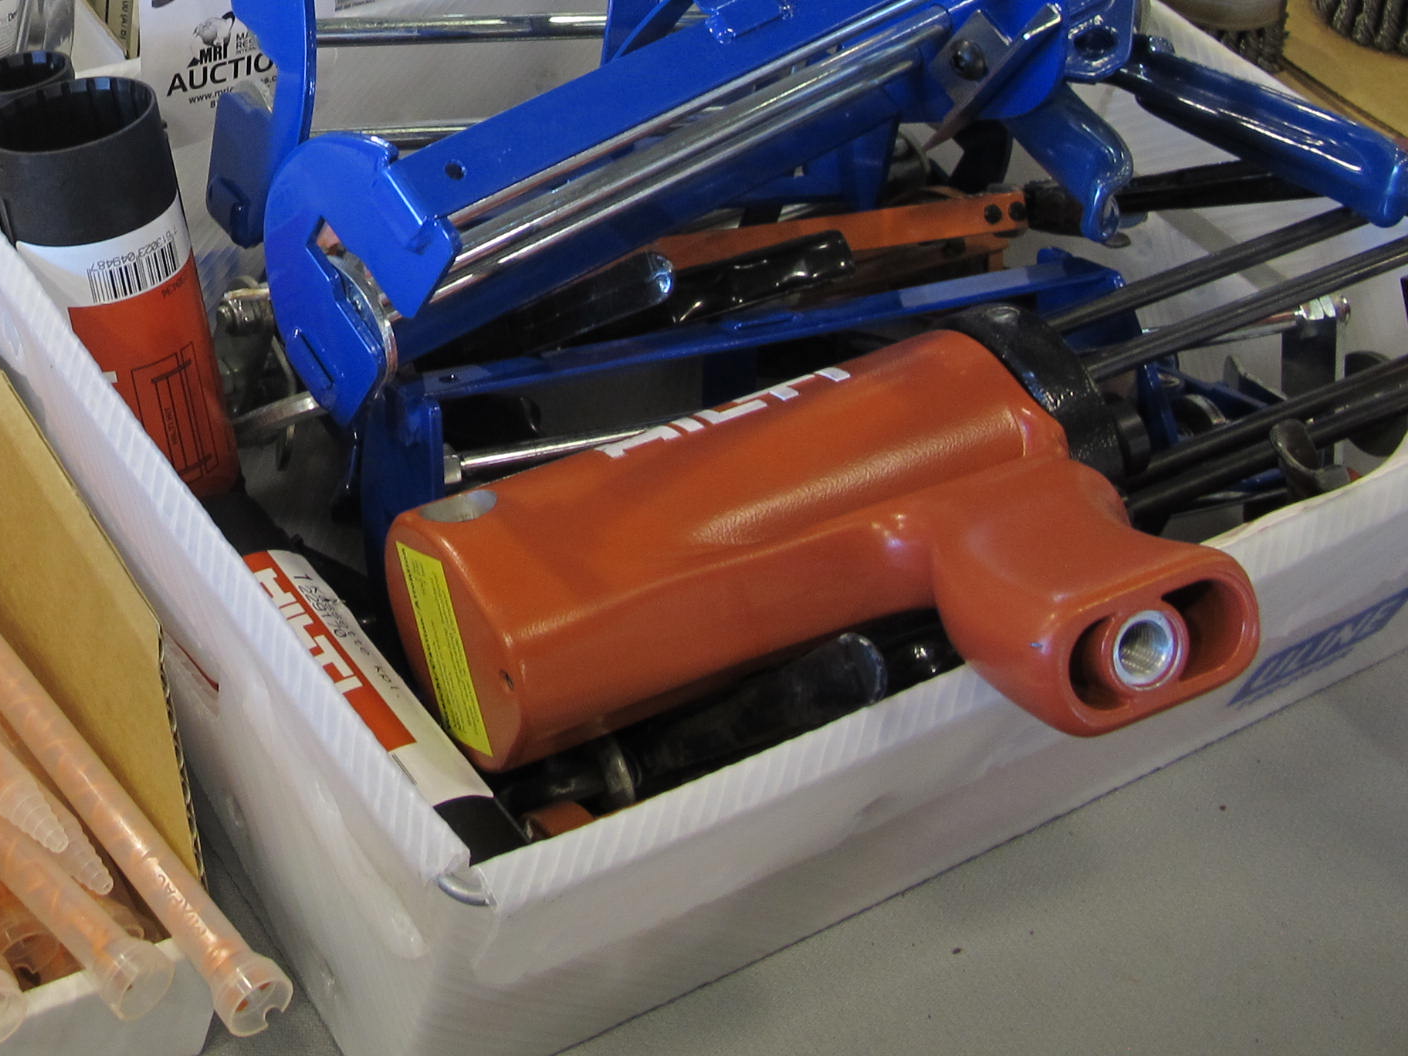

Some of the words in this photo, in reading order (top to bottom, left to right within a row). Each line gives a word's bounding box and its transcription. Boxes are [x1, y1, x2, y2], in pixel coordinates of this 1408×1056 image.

[198, 42, 228, 66] MRI
[166, 52, 275, 97] AUCTIO
[90, 251, 136, 273] 049487
[254, 567, 364, 695] HILTI
